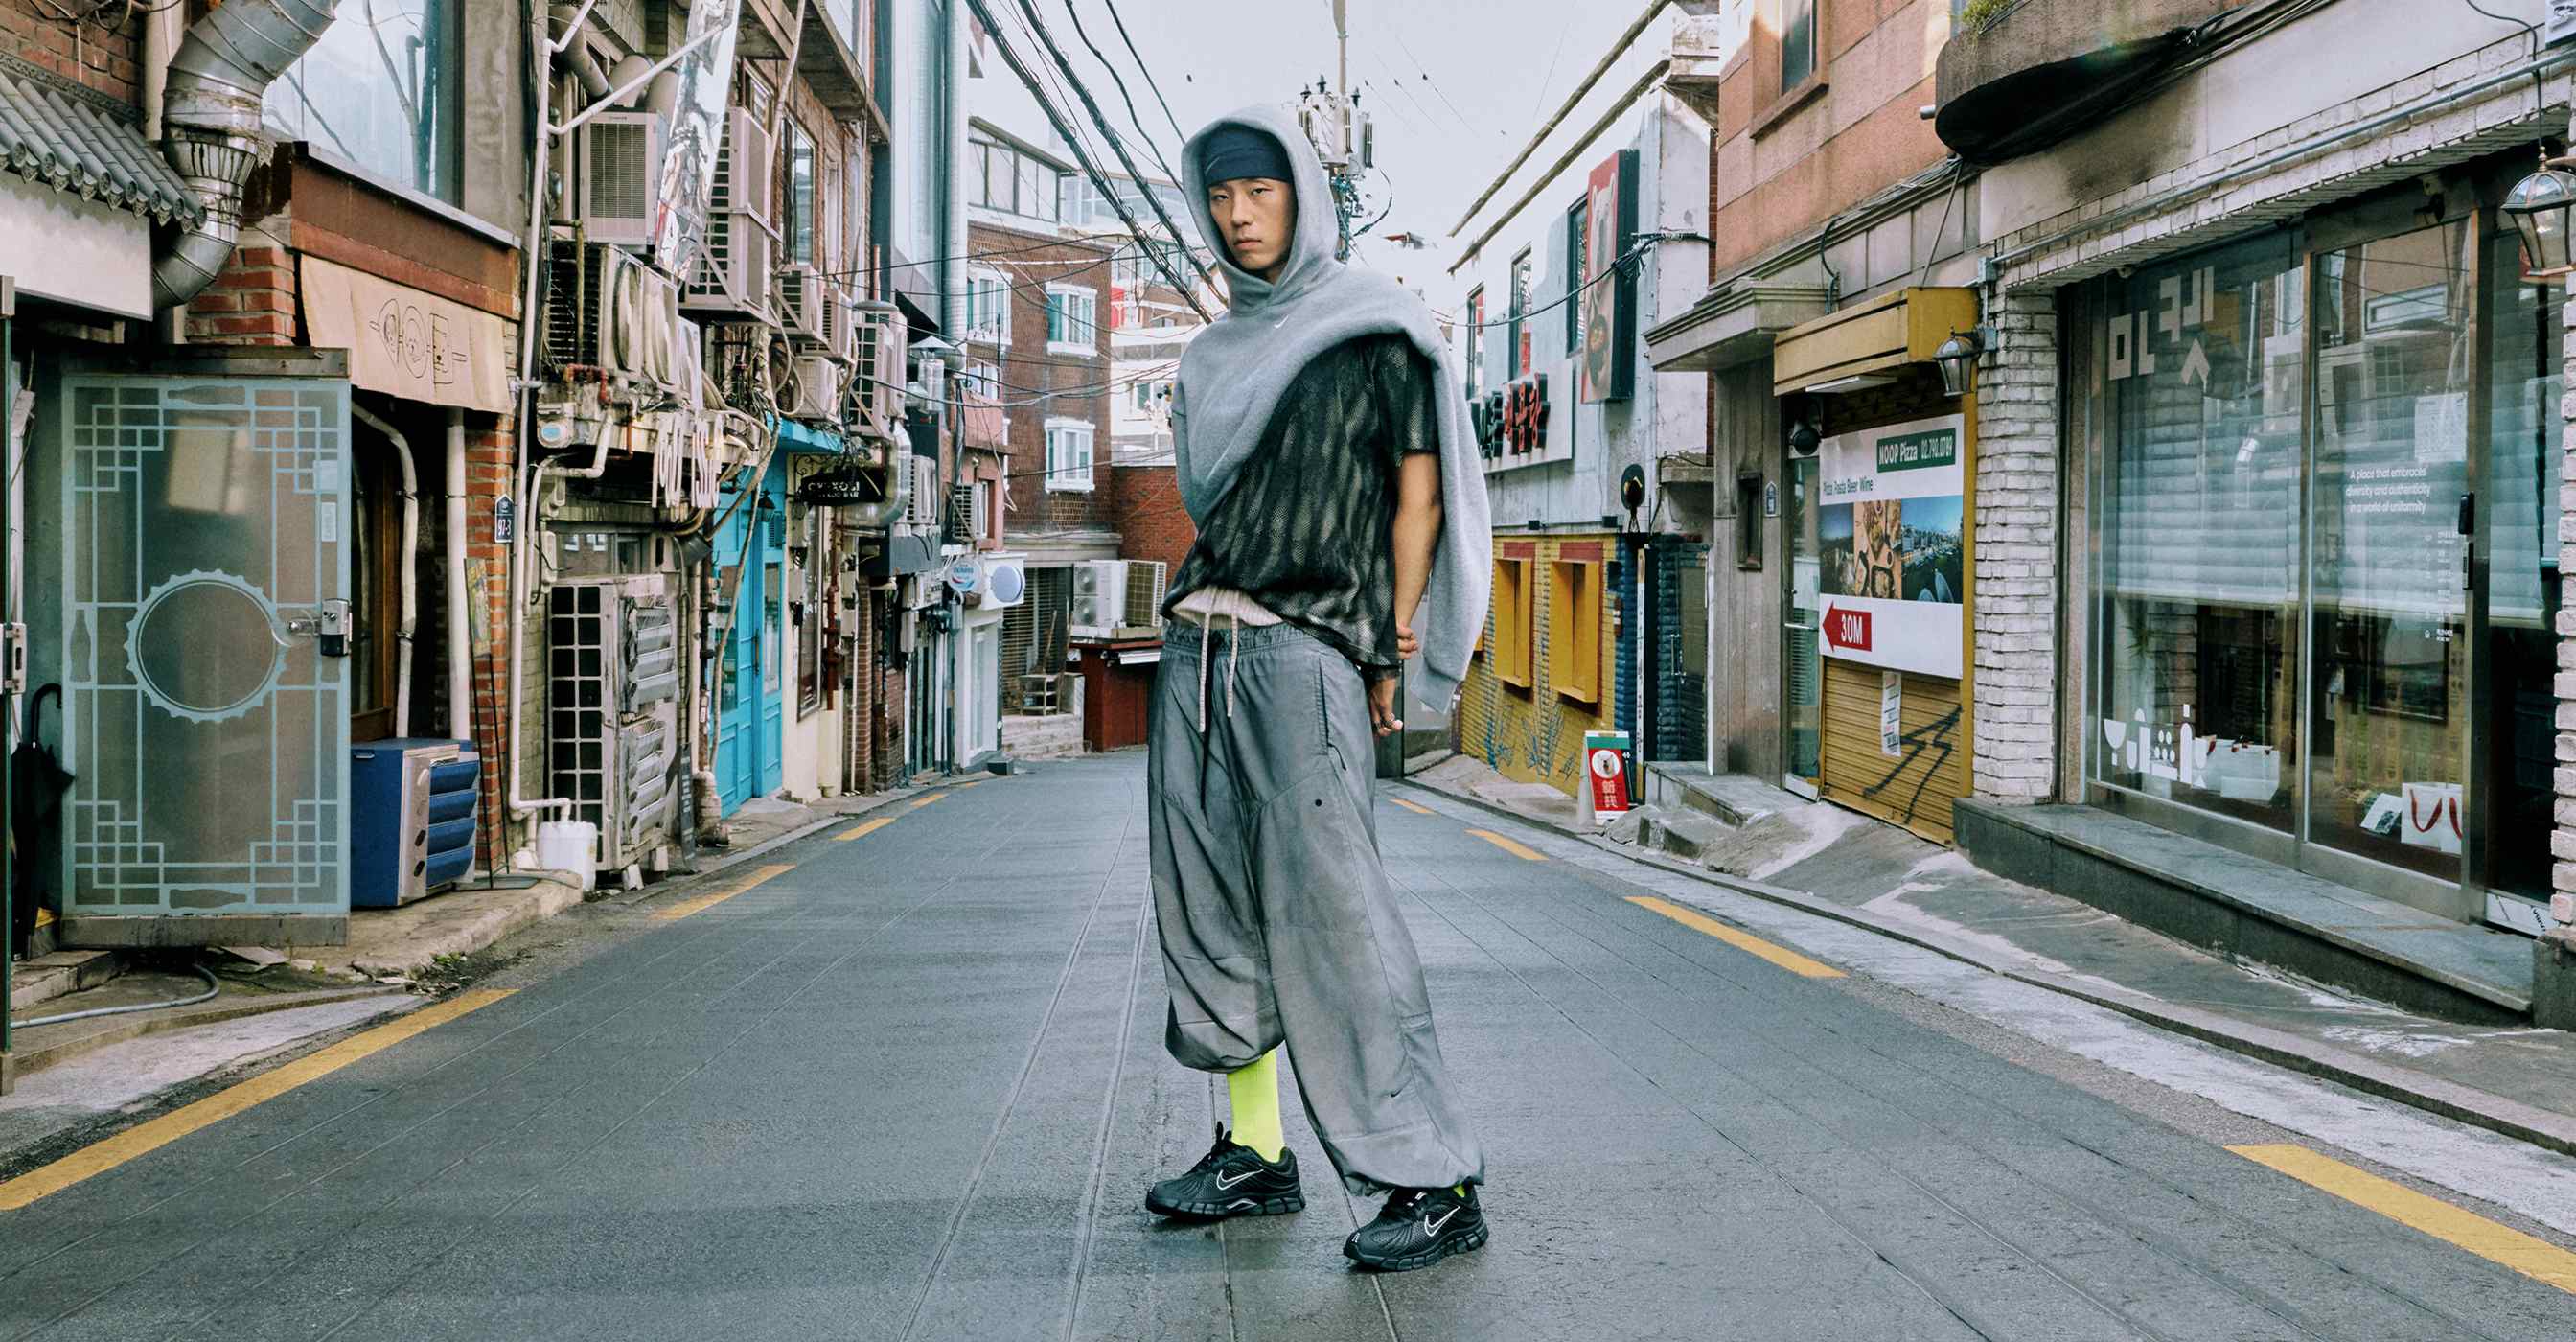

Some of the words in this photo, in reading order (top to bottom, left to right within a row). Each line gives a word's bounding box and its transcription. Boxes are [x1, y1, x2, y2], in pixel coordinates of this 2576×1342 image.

[1900, 442, 1918, 461] Pizza
[2376, 468, 2389, 478] that
[1859, 476, 1873, 491] Wine
[1841, 613, 1863, 645] 30M
